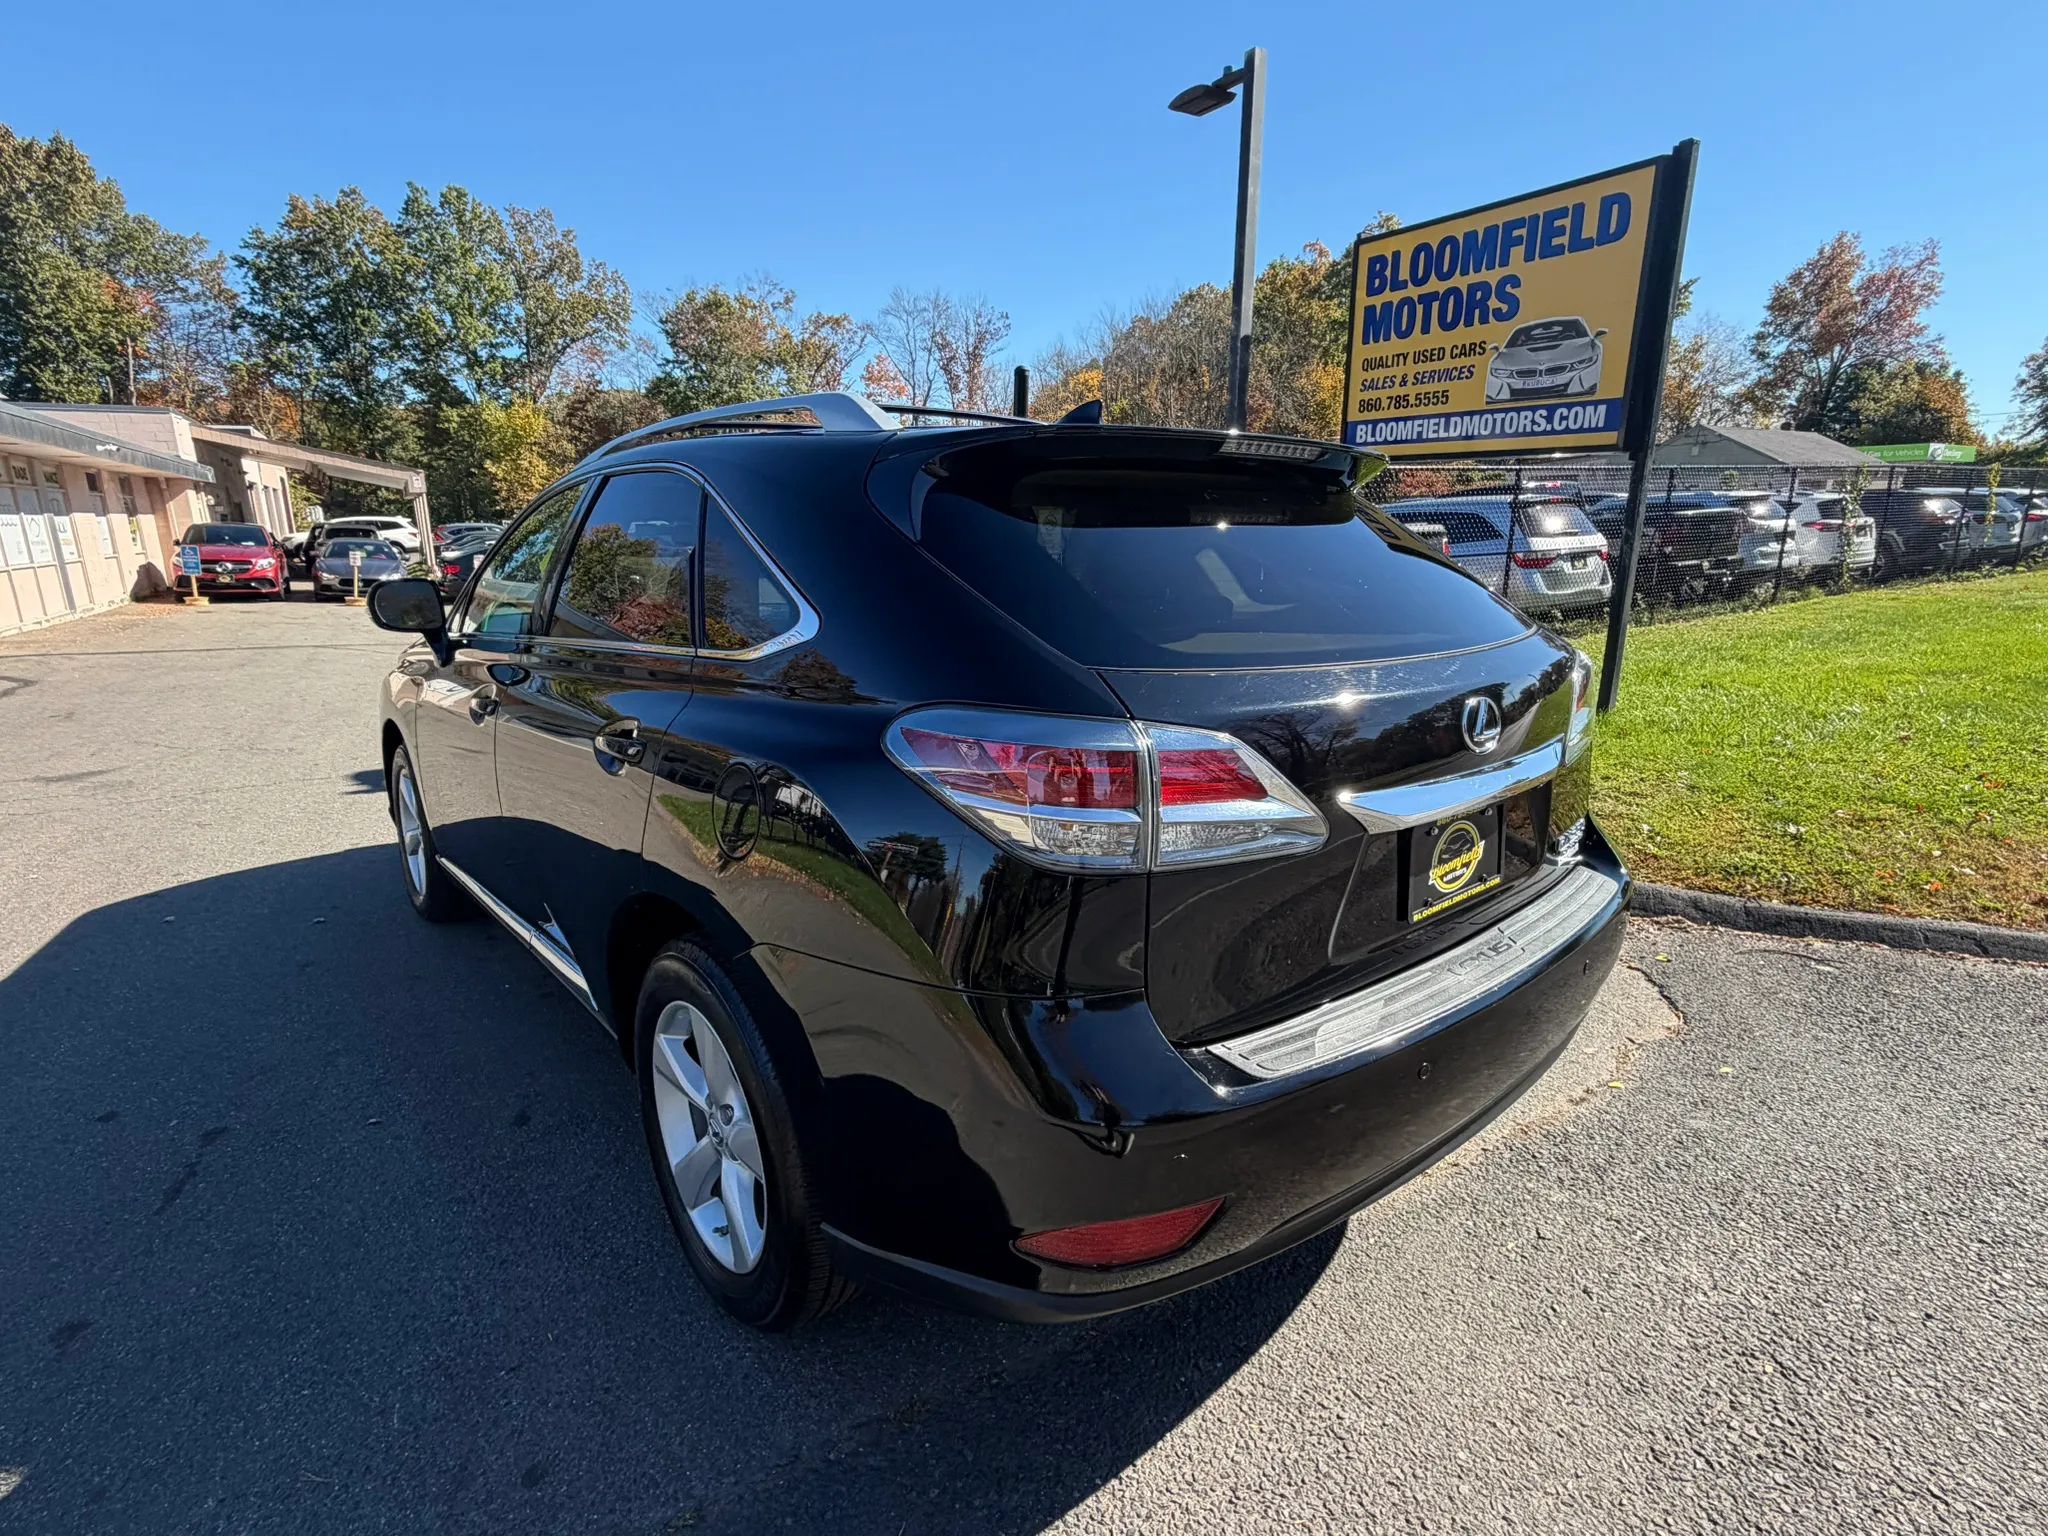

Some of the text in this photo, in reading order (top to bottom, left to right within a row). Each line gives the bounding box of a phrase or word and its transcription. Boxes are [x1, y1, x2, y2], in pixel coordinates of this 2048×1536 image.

[1366, 191, 1632, 298] BLOOMFIELD
[1361, 274, 1521, 345] MOTORS
[1361, 340, 1487, 373] QUALITY USED CARS
[1360, 364, 1476, 393] SALES & SERVICES
[1358, 389, 1450, 414] 860.785.5555
[1355, 404, 1607, 444] BLOOMFIELDMOTORS.COM
[1413, 876, 1501, 922] BLOOMFIELDMOTORS.COM
